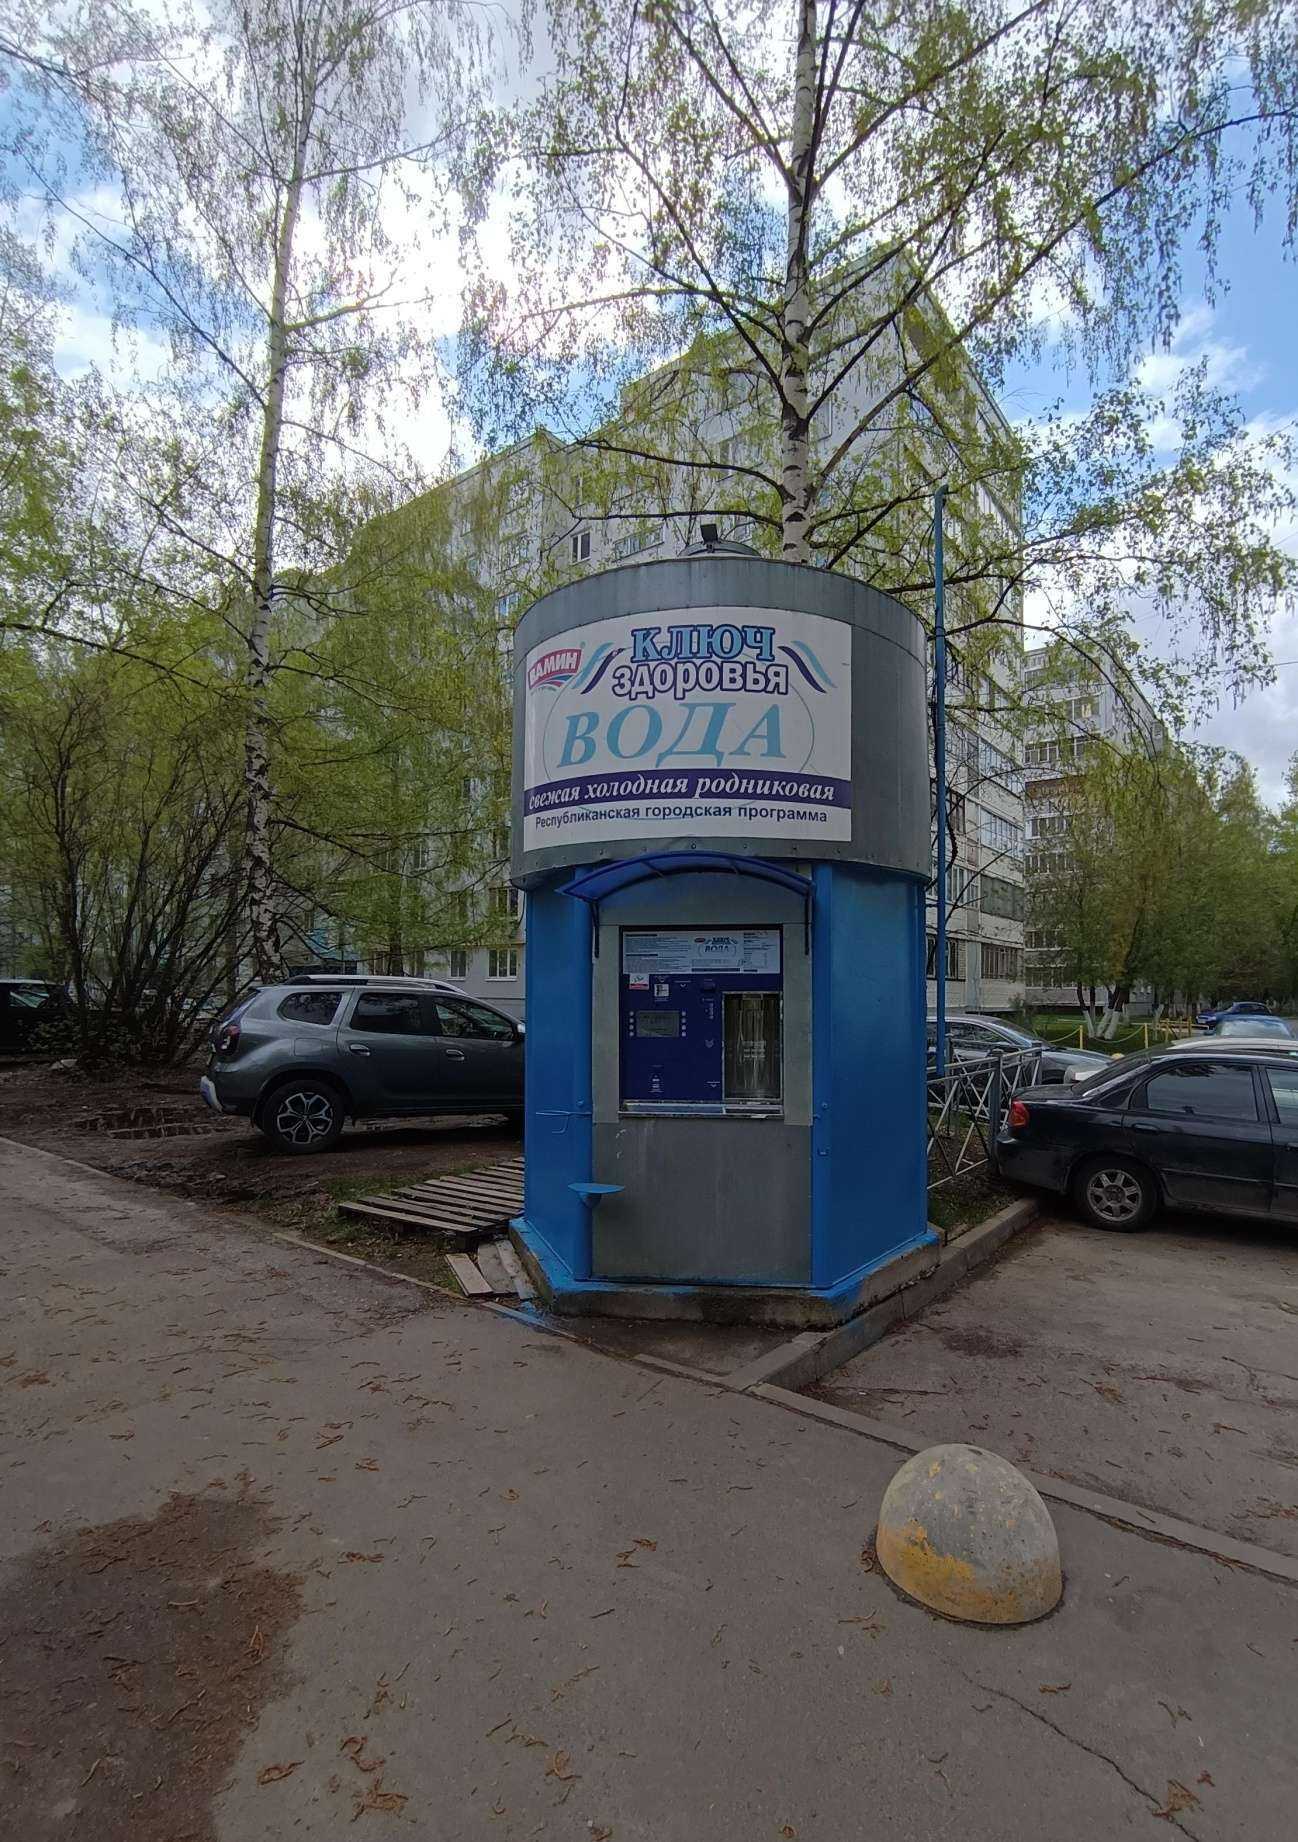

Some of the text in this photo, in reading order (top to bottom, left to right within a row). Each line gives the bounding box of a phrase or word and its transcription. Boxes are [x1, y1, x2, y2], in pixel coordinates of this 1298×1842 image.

[631, 624, 775, 663] КЛЮЧ
[557, 703, 786, 768] ВОДА
[529, 772, 835, 810] свежая холодная родниковая
[535, 806, 827, 831] Республиканская городская программа
